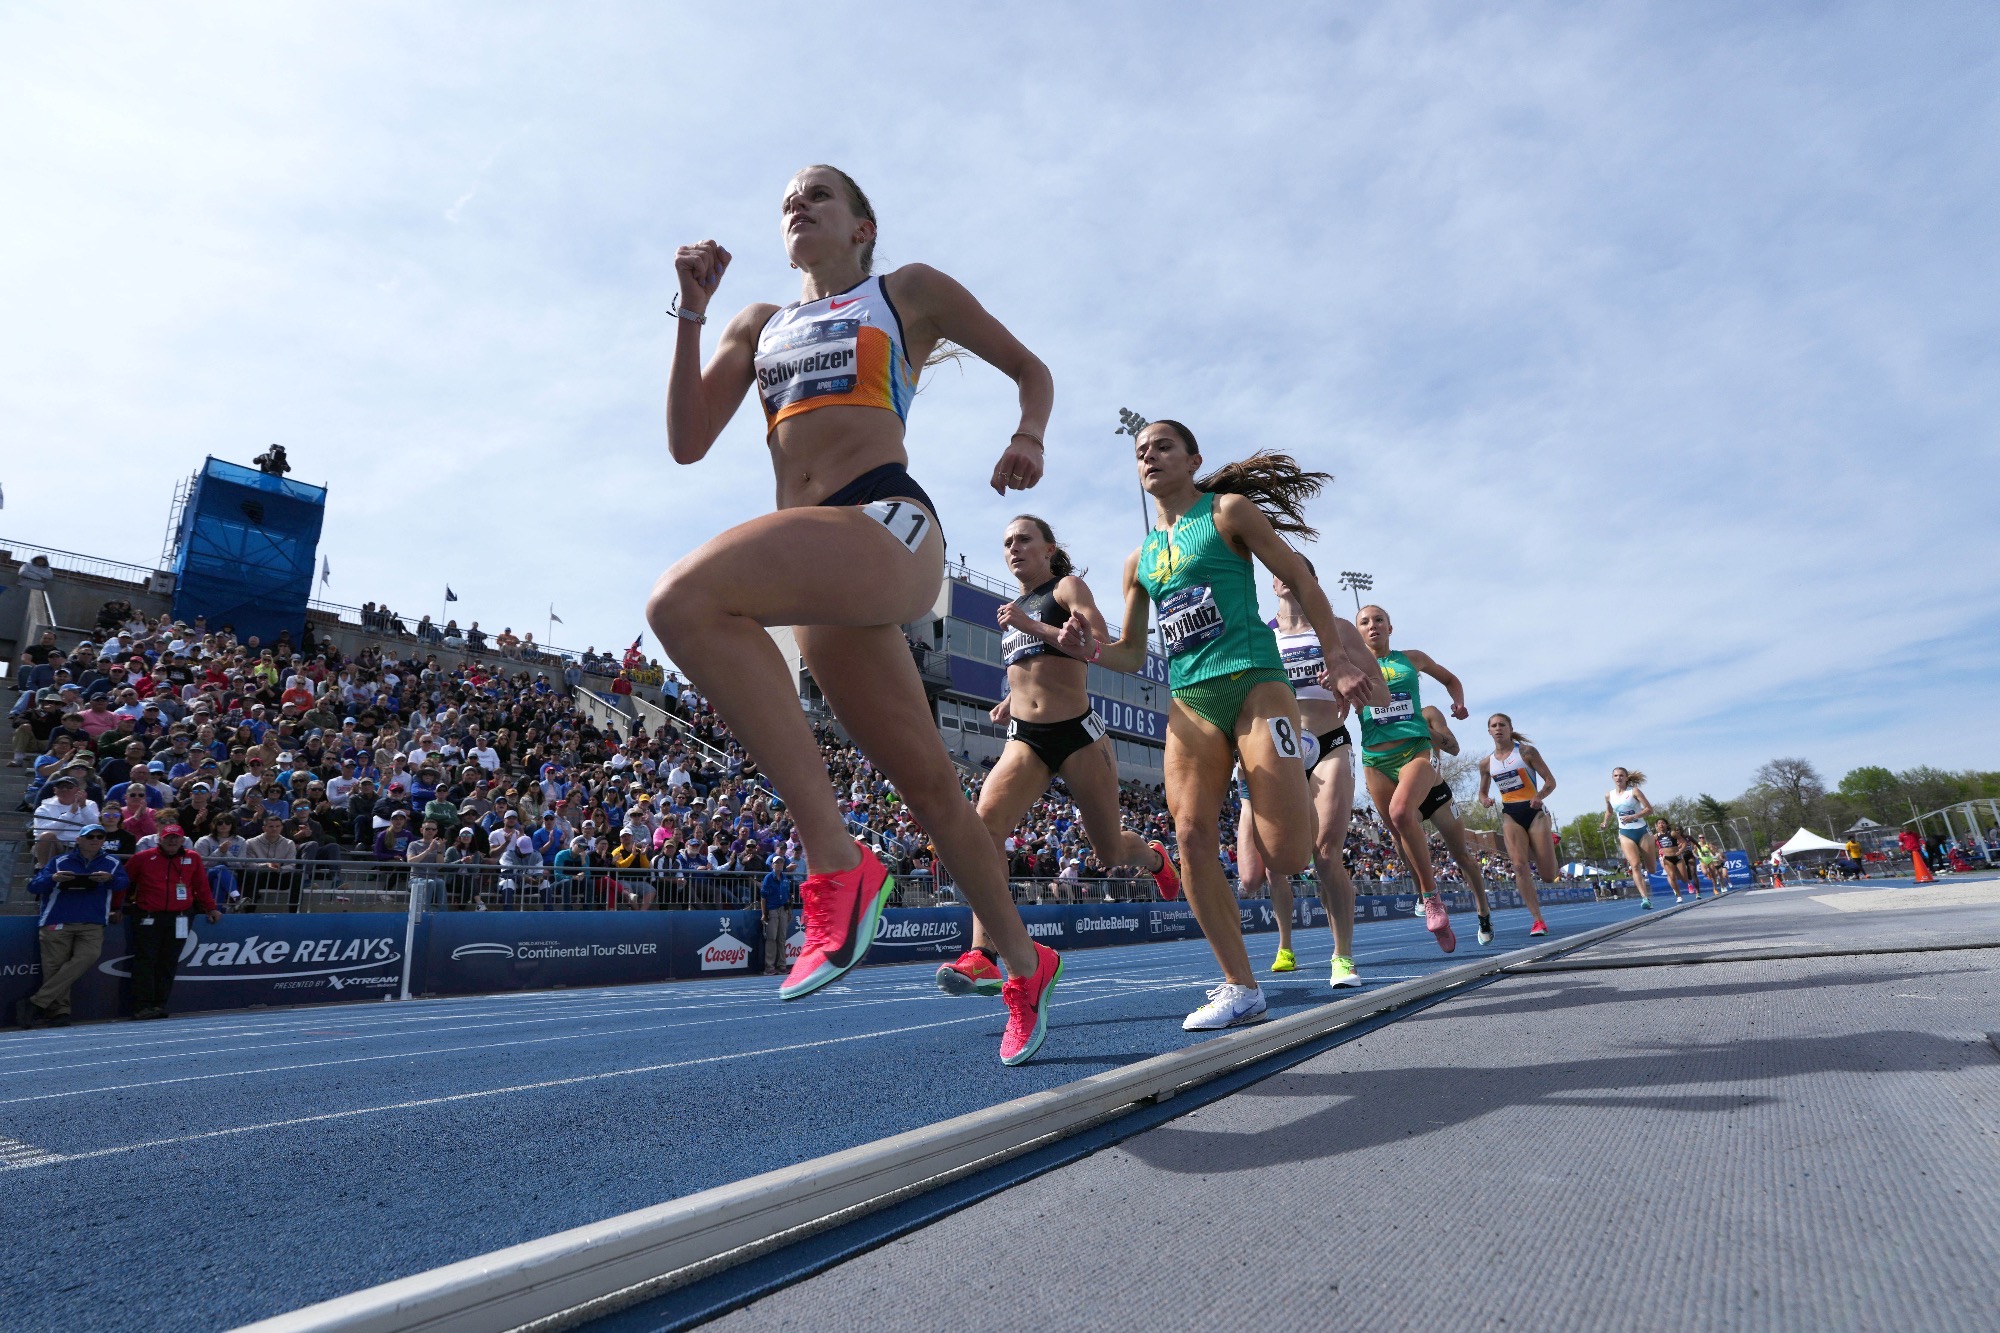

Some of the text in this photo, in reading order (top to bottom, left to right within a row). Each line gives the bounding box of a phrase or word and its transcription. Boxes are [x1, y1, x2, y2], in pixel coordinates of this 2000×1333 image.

[758, 349, 854, 391] Schweizer
[1137, 655, 1165, 682] RS
[1286, 661, 1325, 678] rrent
[1374, 703, 1409, 715] Barnett
[1275, 718, 1296, 756] 8
[1162, 910, 1188, 921] UnityPoint
[875, 915, 958, 939] Drake RELAYS
[1027, 922, 1063, 937] DENTAL
[1076, 916, 1139, 934] @DrakeRelays
[292, 937, 394, 963] RELAYS
[517, 943, 657, 959] Continental Tour SILVER
[705, 946, 746, 965] Casey's
[0, 963, 41, 977] NCE
[273, 980, 326, 990] PRESENTED BY
[344, 976, 399, 985] XTREAM
